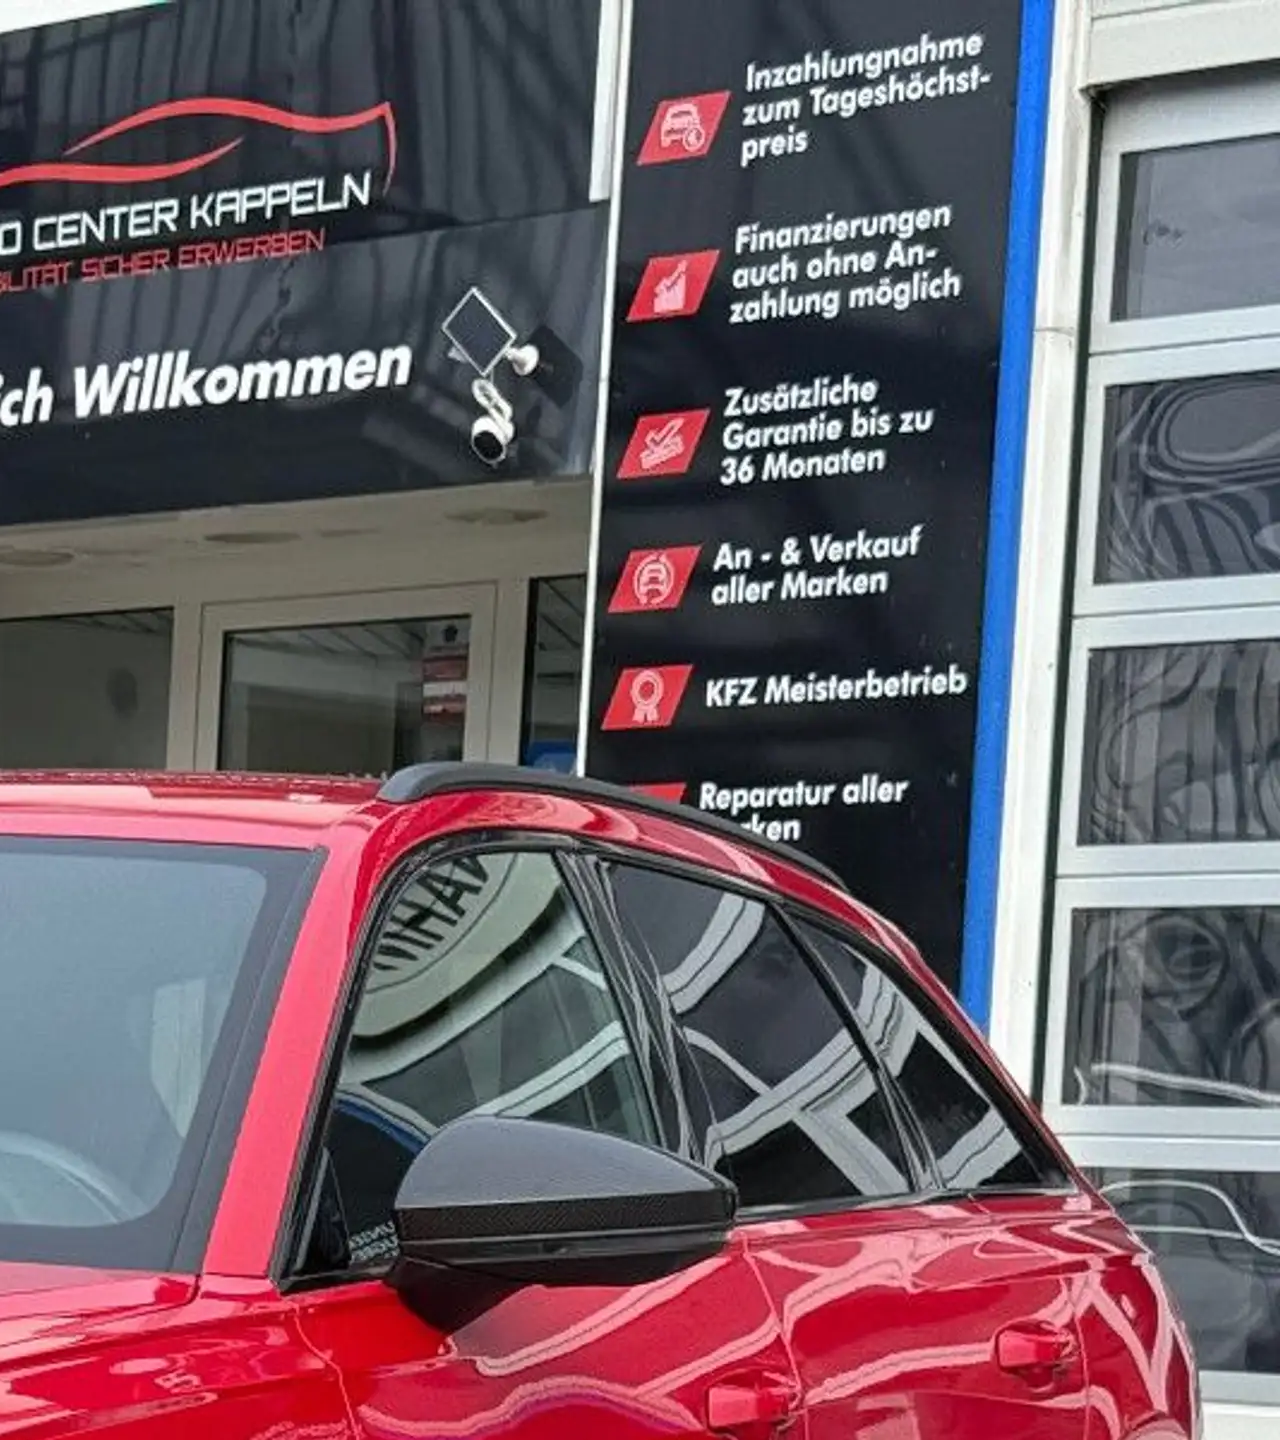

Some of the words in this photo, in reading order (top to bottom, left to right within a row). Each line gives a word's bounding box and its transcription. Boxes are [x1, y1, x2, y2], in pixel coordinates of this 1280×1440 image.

[746, 33, 983, 92] Inzahlungnahme
[742, 94, 800, 126] zum
[810, 65, 991, 117] Tageshöchst-
[740, 126, 808, 166] preis
[33, 203, 178, 251] CENTER
[190, 172, 370, 228] KAPPELN
[735, 204, 951, 254] Finanzierungen
[81, 249, 170, 282] SICHER
[178, 228, 324, 270] ERWERBEN
[732, 256, 797, 290] auch
[806, 250, 877, 282] ohne
[885, 243, 938, 271] An-
[729, 287, 839, 324] zahlung
[848, 271, 960, 311] möglich
[74, 345, 411, 420] Willkommen
[723, 374, 877, 416] Zusätzliche
[721, 413, 843, 451] Garantie
[851, 411, 892, 440] bis
[900, 408, 933, 434] zu
[720, 456, 755, 487] 36
[762, 448, 886, 481] Monaten
[713, 543, 753, 572] An
[781, 538, 801, 565] &
[810, 524, 923, 562] Verkauf
[711, 573, 774, 606] aller
[780, 567, 888, 601] Marken
[705, 680, 757, 708] KFZ
[763, 664, 967, 703] Meisterbetrieb
[699, 780, 837, 817] Reparatur
[843, 775, 909, 805] aller
